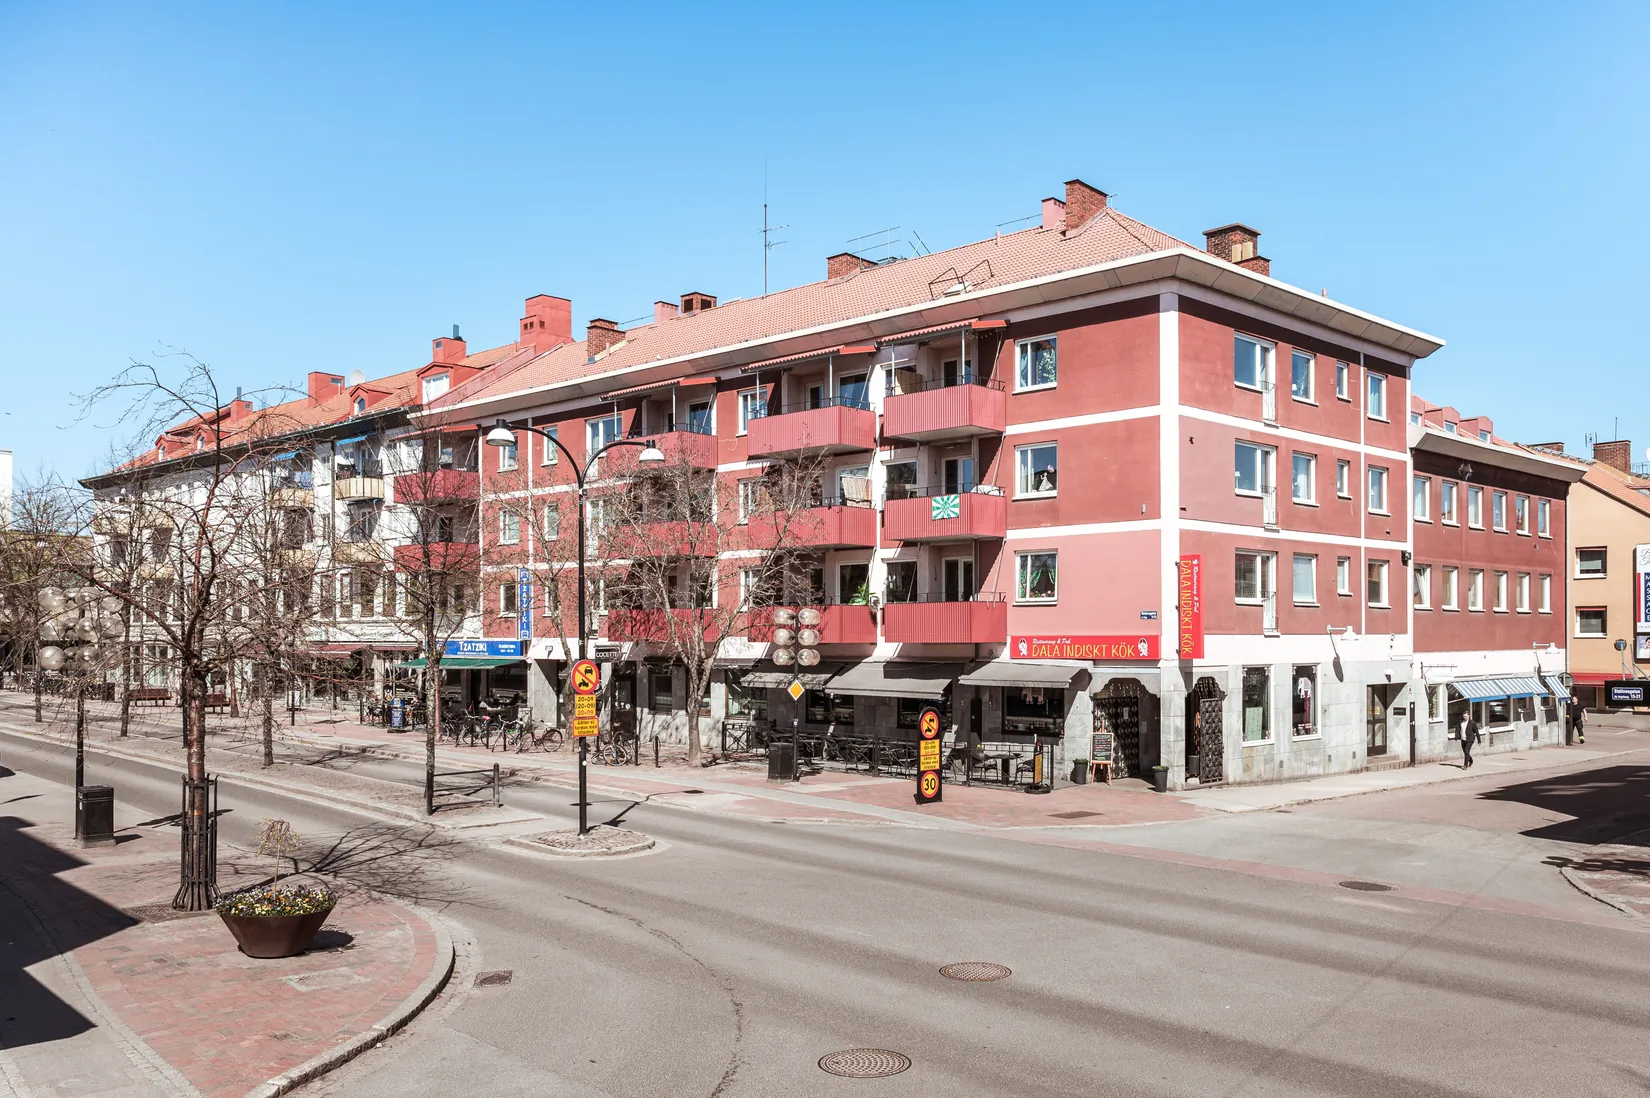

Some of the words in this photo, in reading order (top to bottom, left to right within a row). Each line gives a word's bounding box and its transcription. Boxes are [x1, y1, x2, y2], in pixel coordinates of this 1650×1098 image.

[1180, 560, 1192, 587] DALA
[1181, 590, 1192, 630] INDISKT
[458, 641, 487, 652] TZATZIKI
[1032, 644, 1060, 657] DALA
[1063, 644, 1108, 658] INDISKT
[1111, 642, 1135, 658] KÖK
[1181, 633, 1194, 655] KÖK
[924, 778, 936, 791] 30
